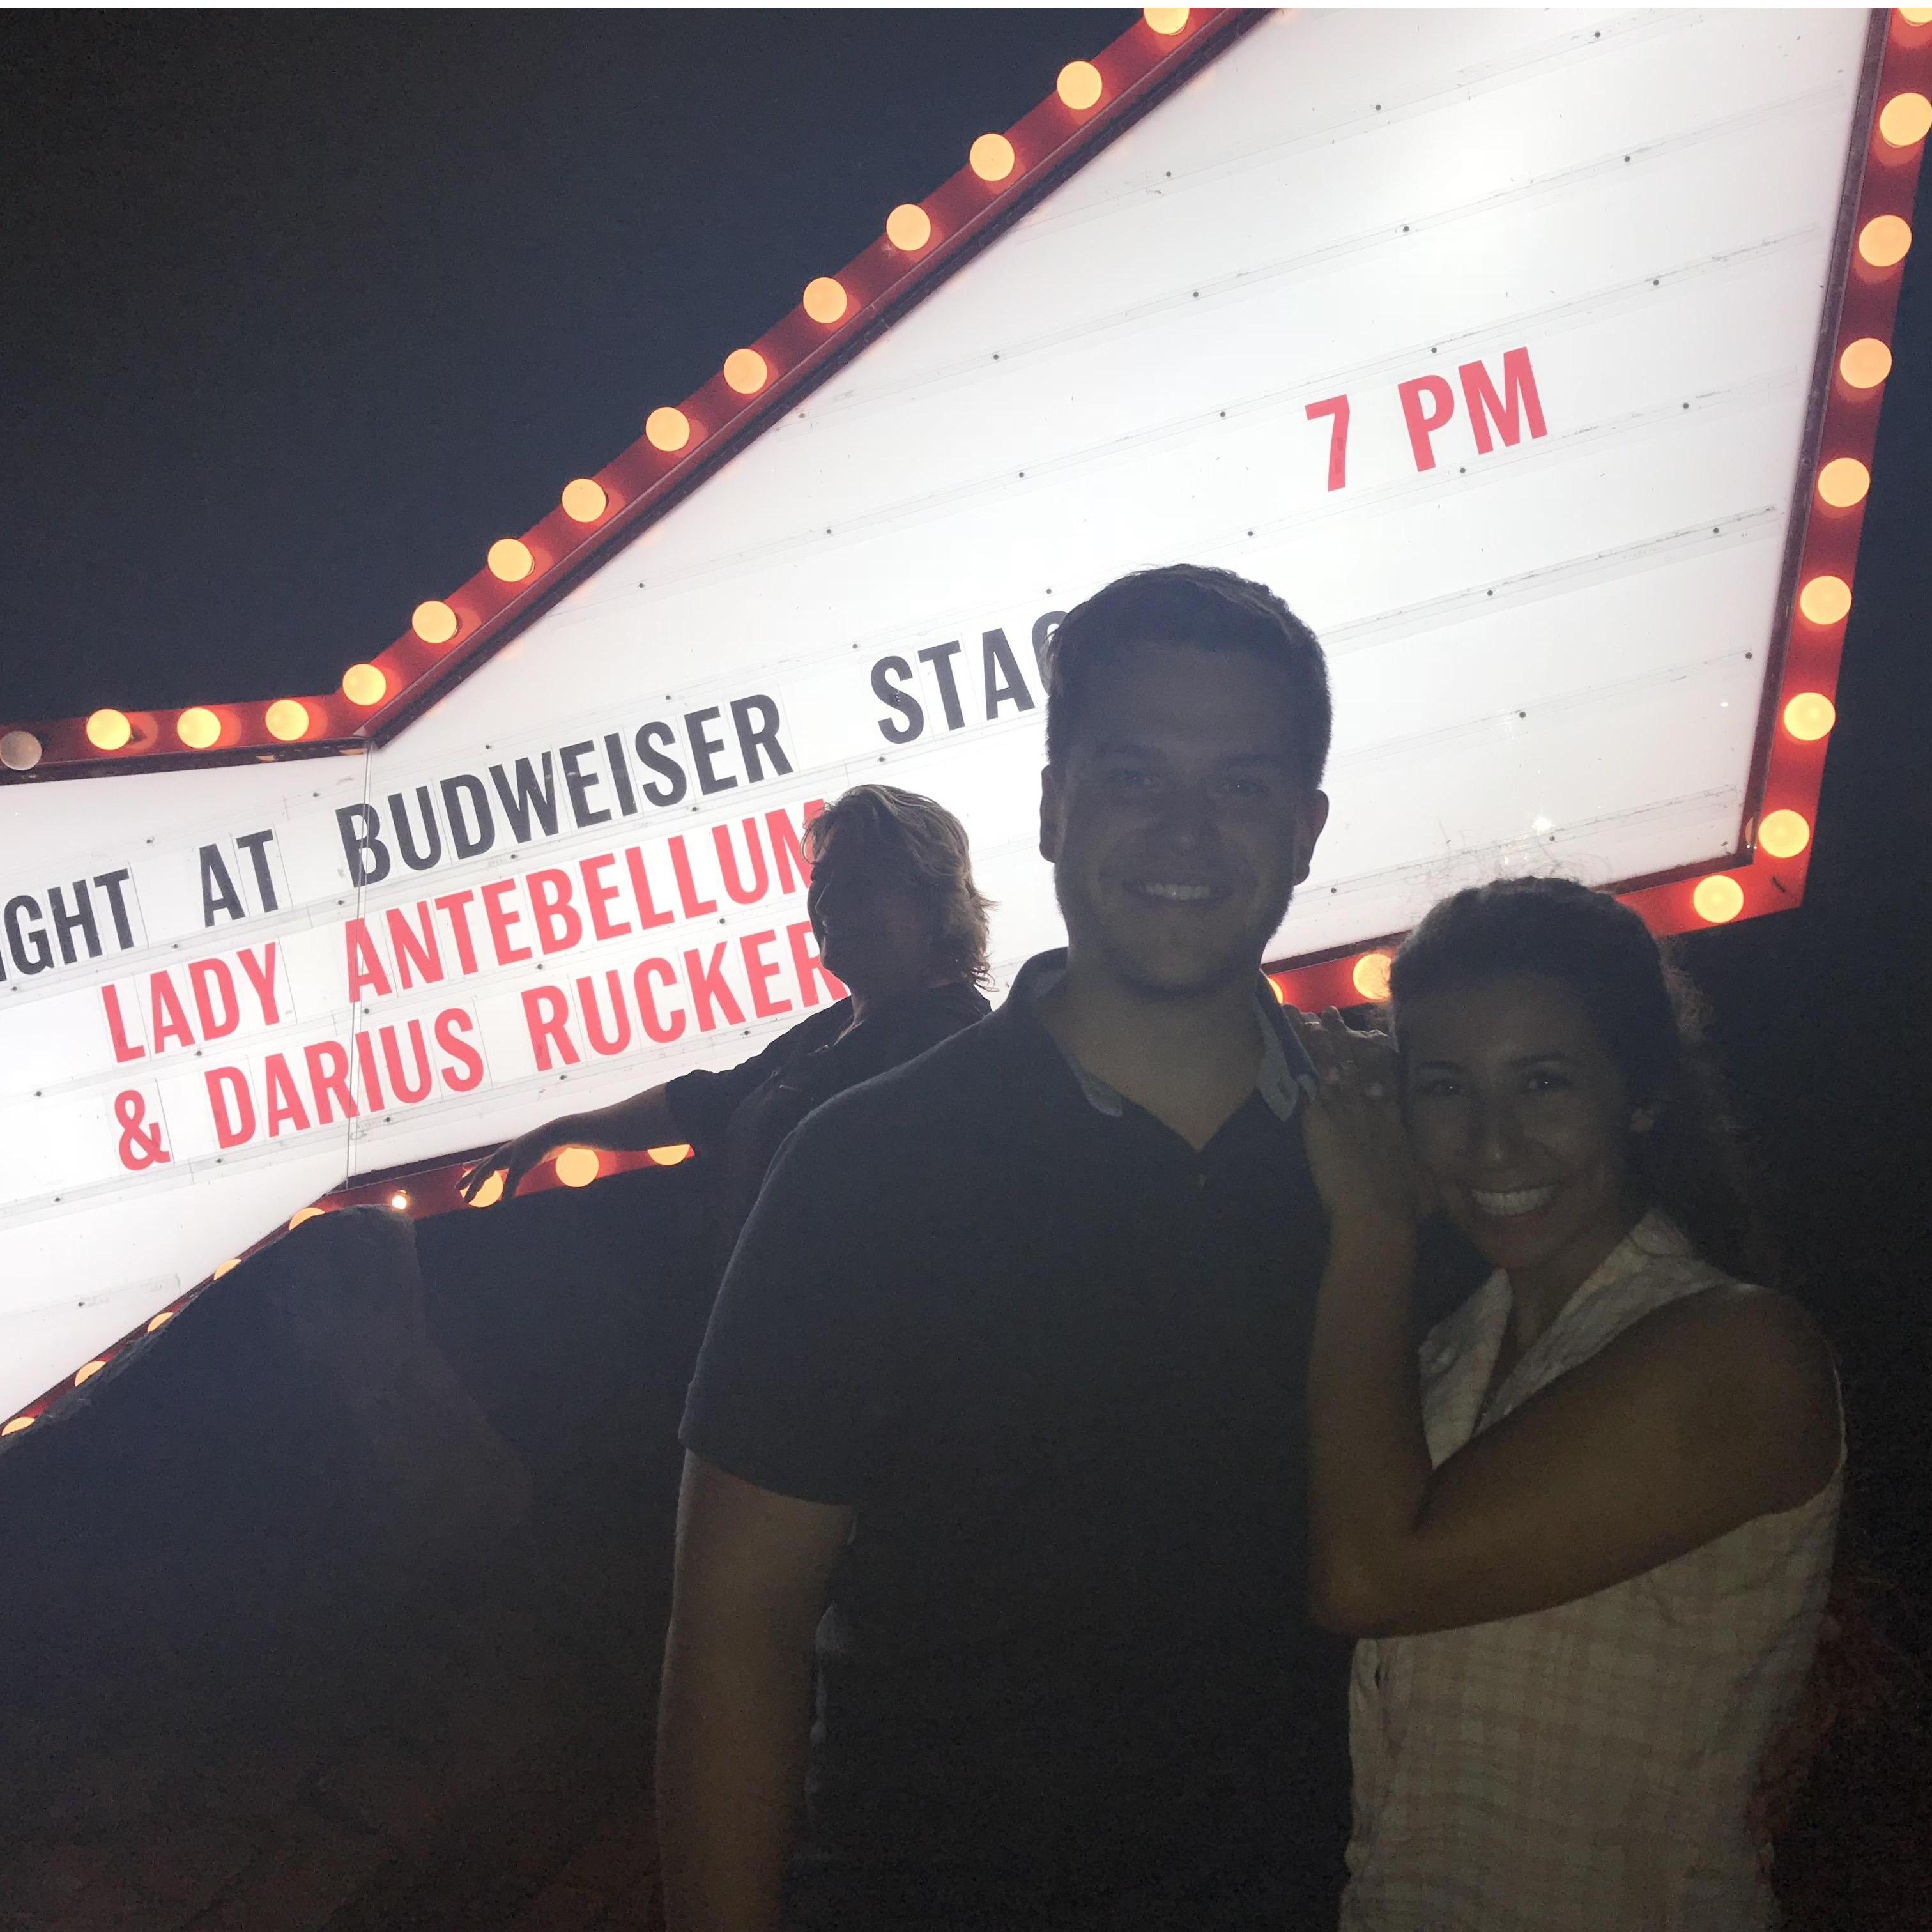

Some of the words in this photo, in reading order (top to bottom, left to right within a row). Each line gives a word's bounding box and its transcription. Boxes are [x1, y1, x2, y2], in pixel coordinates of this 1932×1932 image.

[1305, 394, 1350, 492] 7
[1397, 346, 1548, 472] PM
[0, 868, 135, 982] GHT
[199, 829, 279, 927] AT
[335, 694, 793, 888] BUDWEISER
[100, 942, 280, 1064] LADY
[114, 1089, 171, 1170] &
[204, 1008, 484, 1149] DARIUS
[521, 920, 850, 1071] RUCKER
